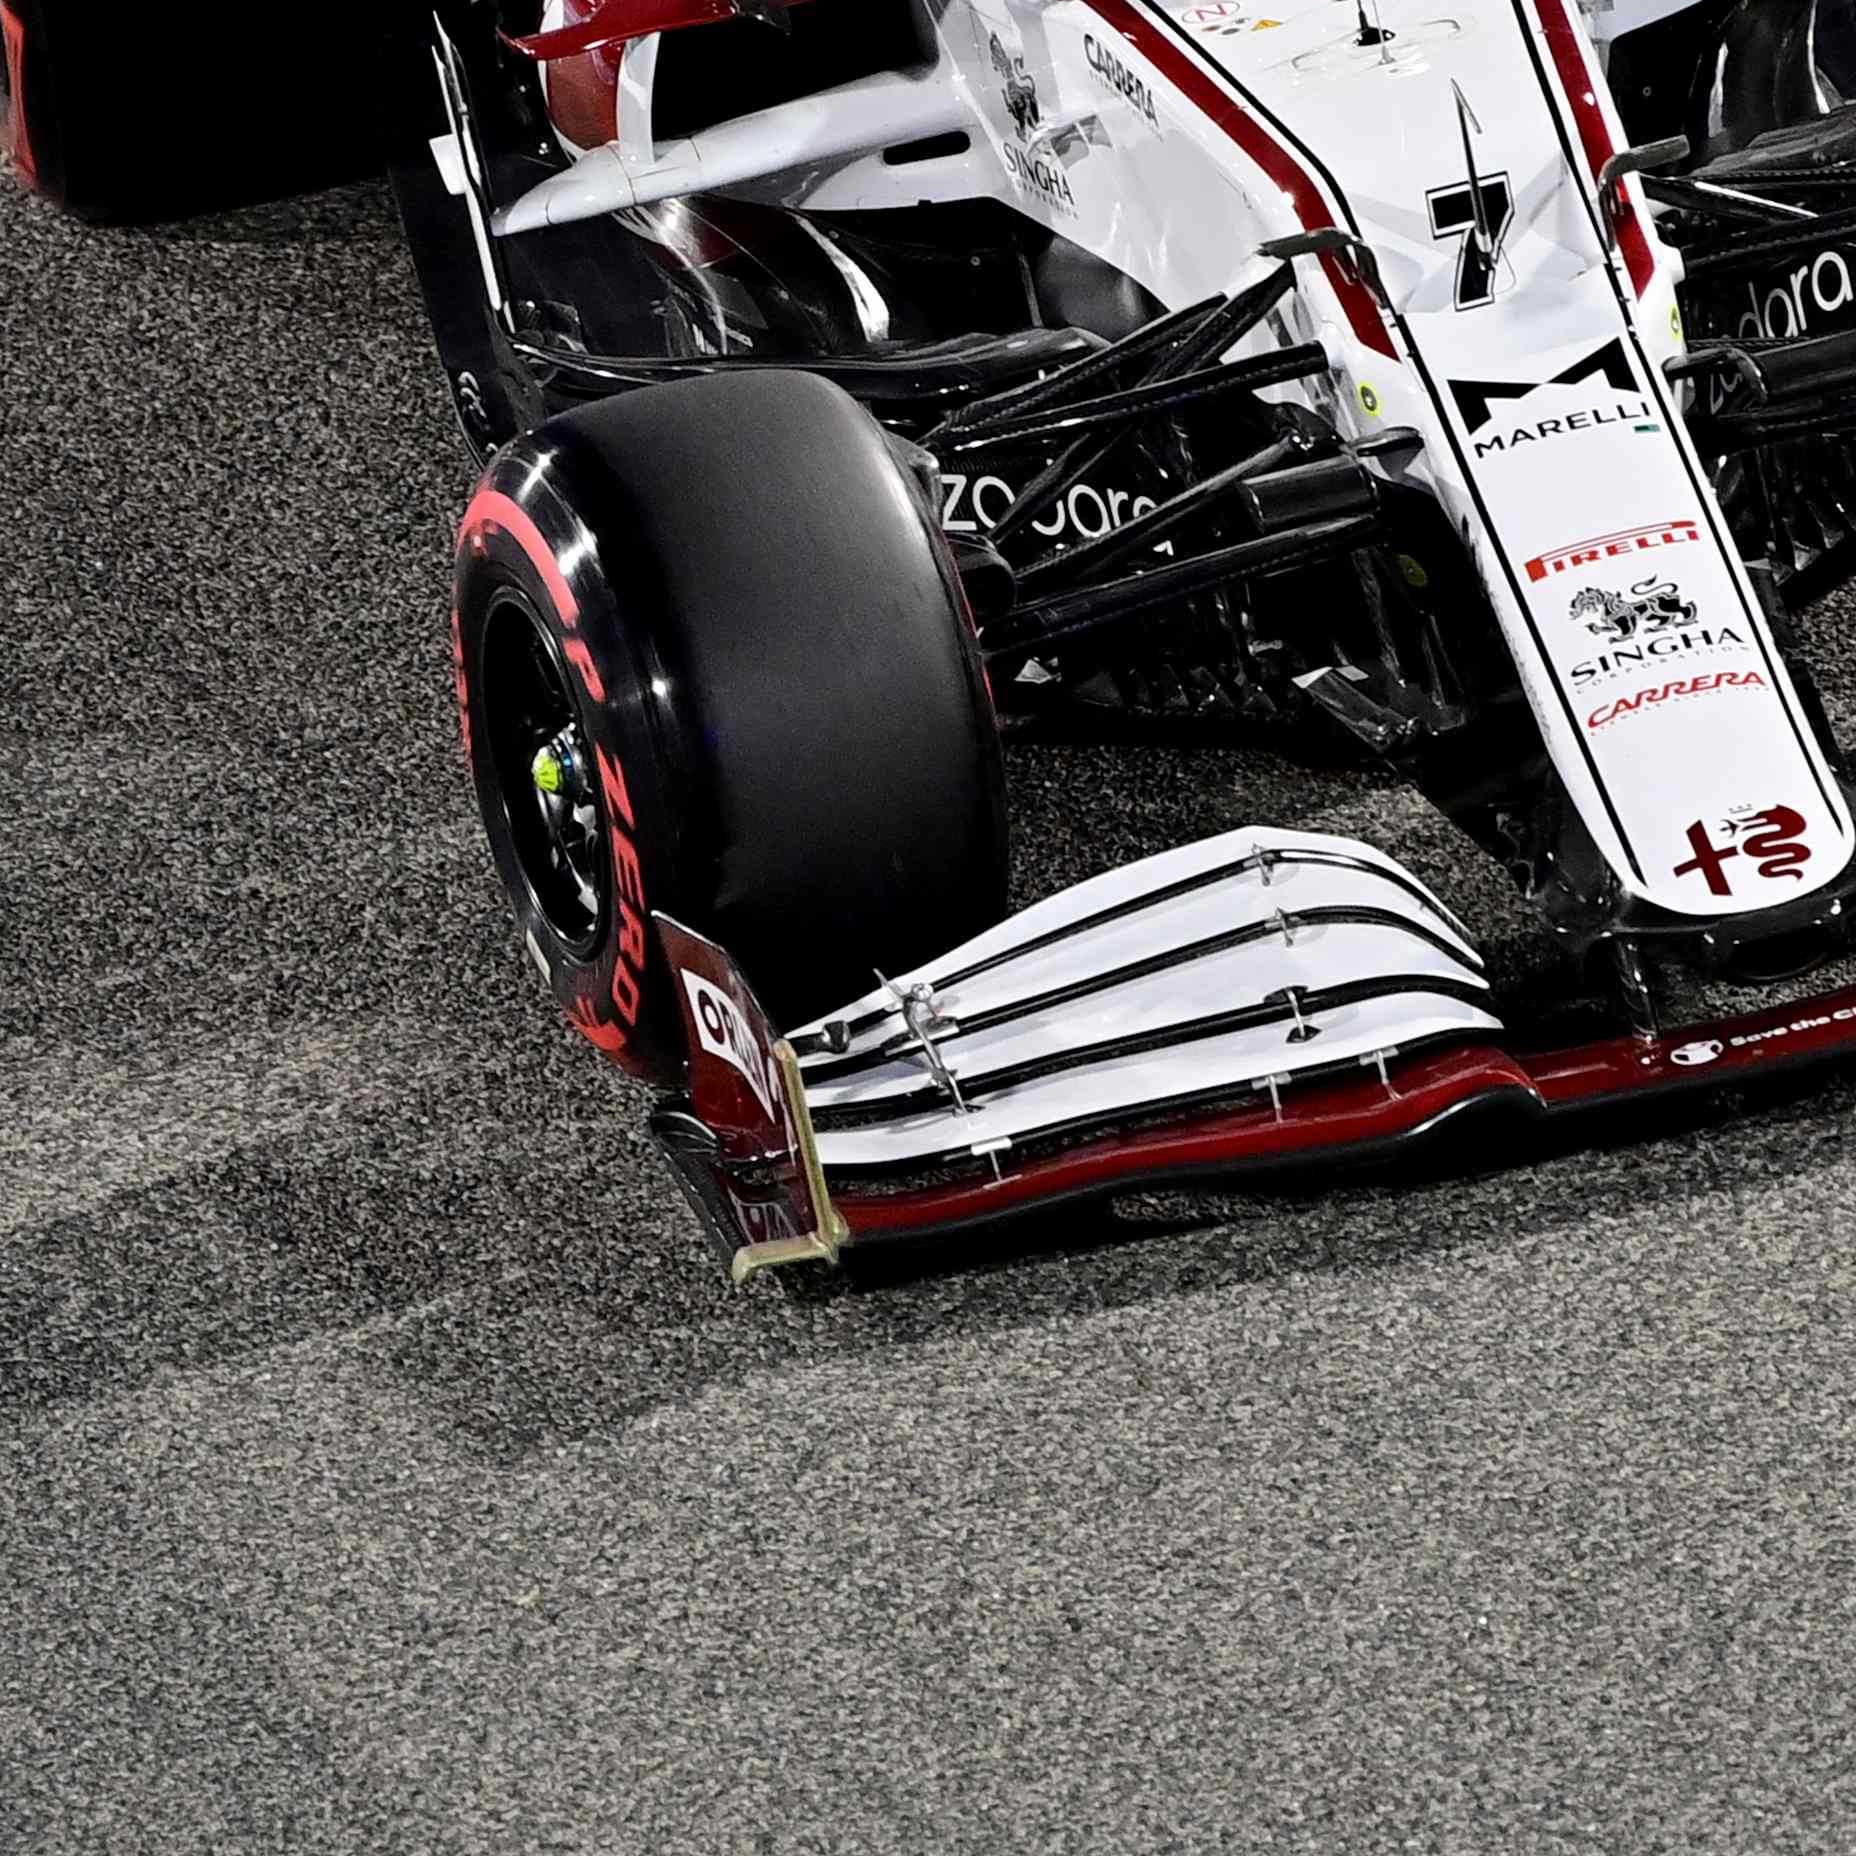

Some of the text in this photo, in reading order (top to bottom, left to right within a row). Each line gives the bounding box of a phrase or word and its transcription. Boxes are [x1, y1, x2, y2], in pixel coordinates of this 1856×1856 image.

[1004, 142, 1075, 206] SINGHA
[1425, 170, 1515, 311] 7
[1474, 402, 1652, 457] MARELLI
[1525, 521, 1700, 582] PIRELLI
[1571, 627, 1746, 686] SINGHA
[1588, 672, 1767, 728] CARRERA
[1730, 1027, 1788, 1046] Save
[1790, 1016, 1831, 1031] the
